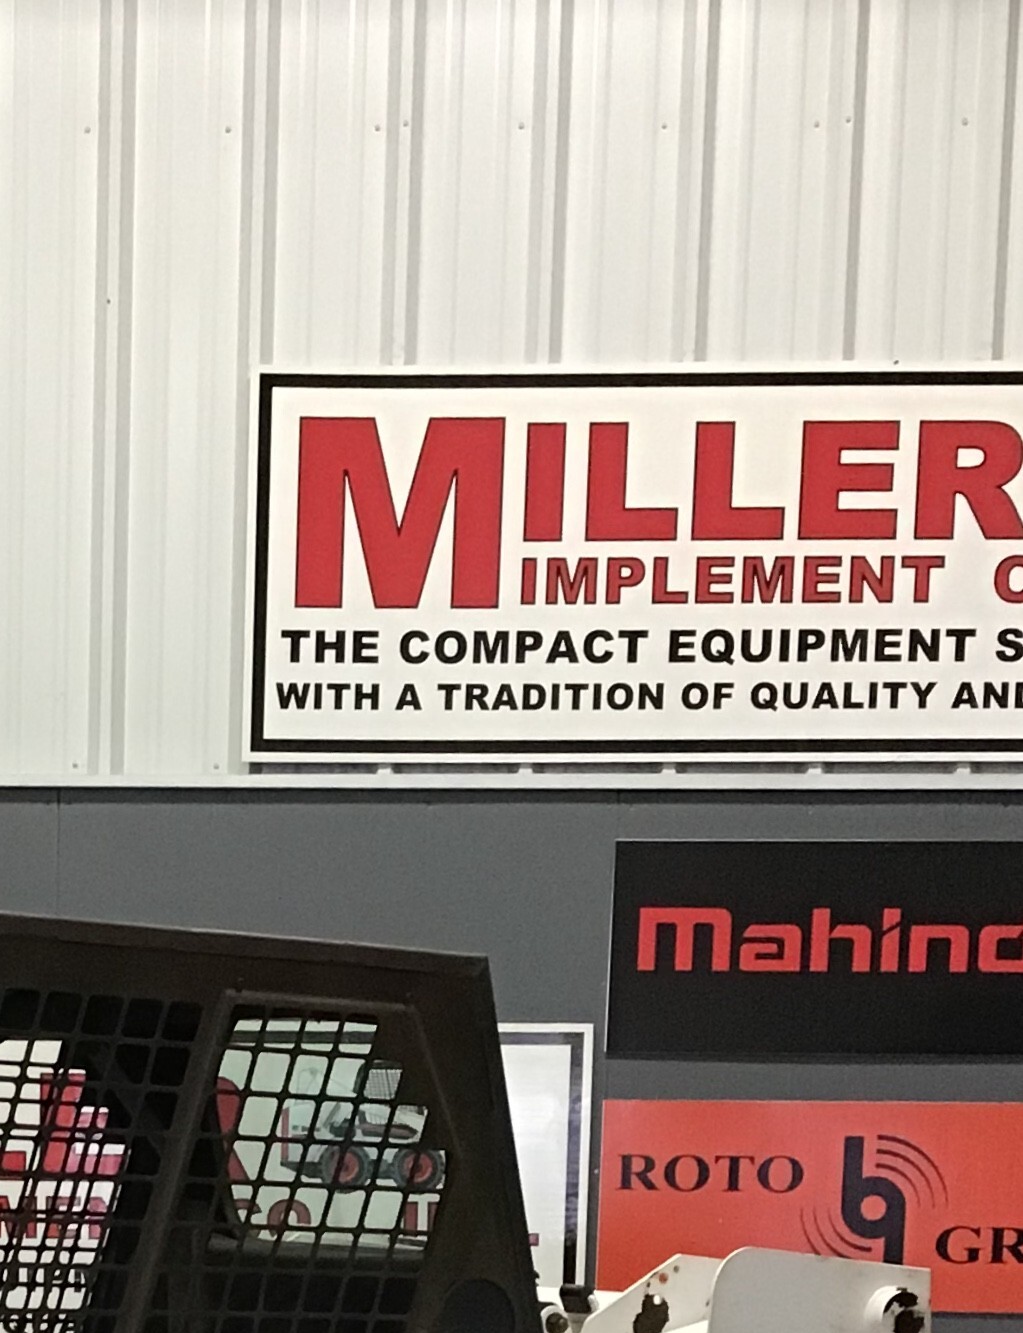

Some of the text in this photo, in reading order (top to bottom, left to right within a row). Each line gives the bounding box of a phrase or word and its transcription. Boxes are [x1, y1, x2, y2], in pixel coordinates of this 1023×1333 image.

[295, 417, 1023, 610] MILLER
[521, 556, 947, 606] IMPLEMENT
[281, 630, 380, 666] THE
[399, 630, 650, 666] COMPACT
[669, 629, 978, 667] EQUIPMENT
[276, 683, 381, 712] WITH
[396, 684, 423, 712] A
[438, 684, 666, 712] TRADITION
[682, 683, 736, 712] OF
[751, 682, 938, 713] QUALITY
[617, 1154, 805, 1194] ROTO
